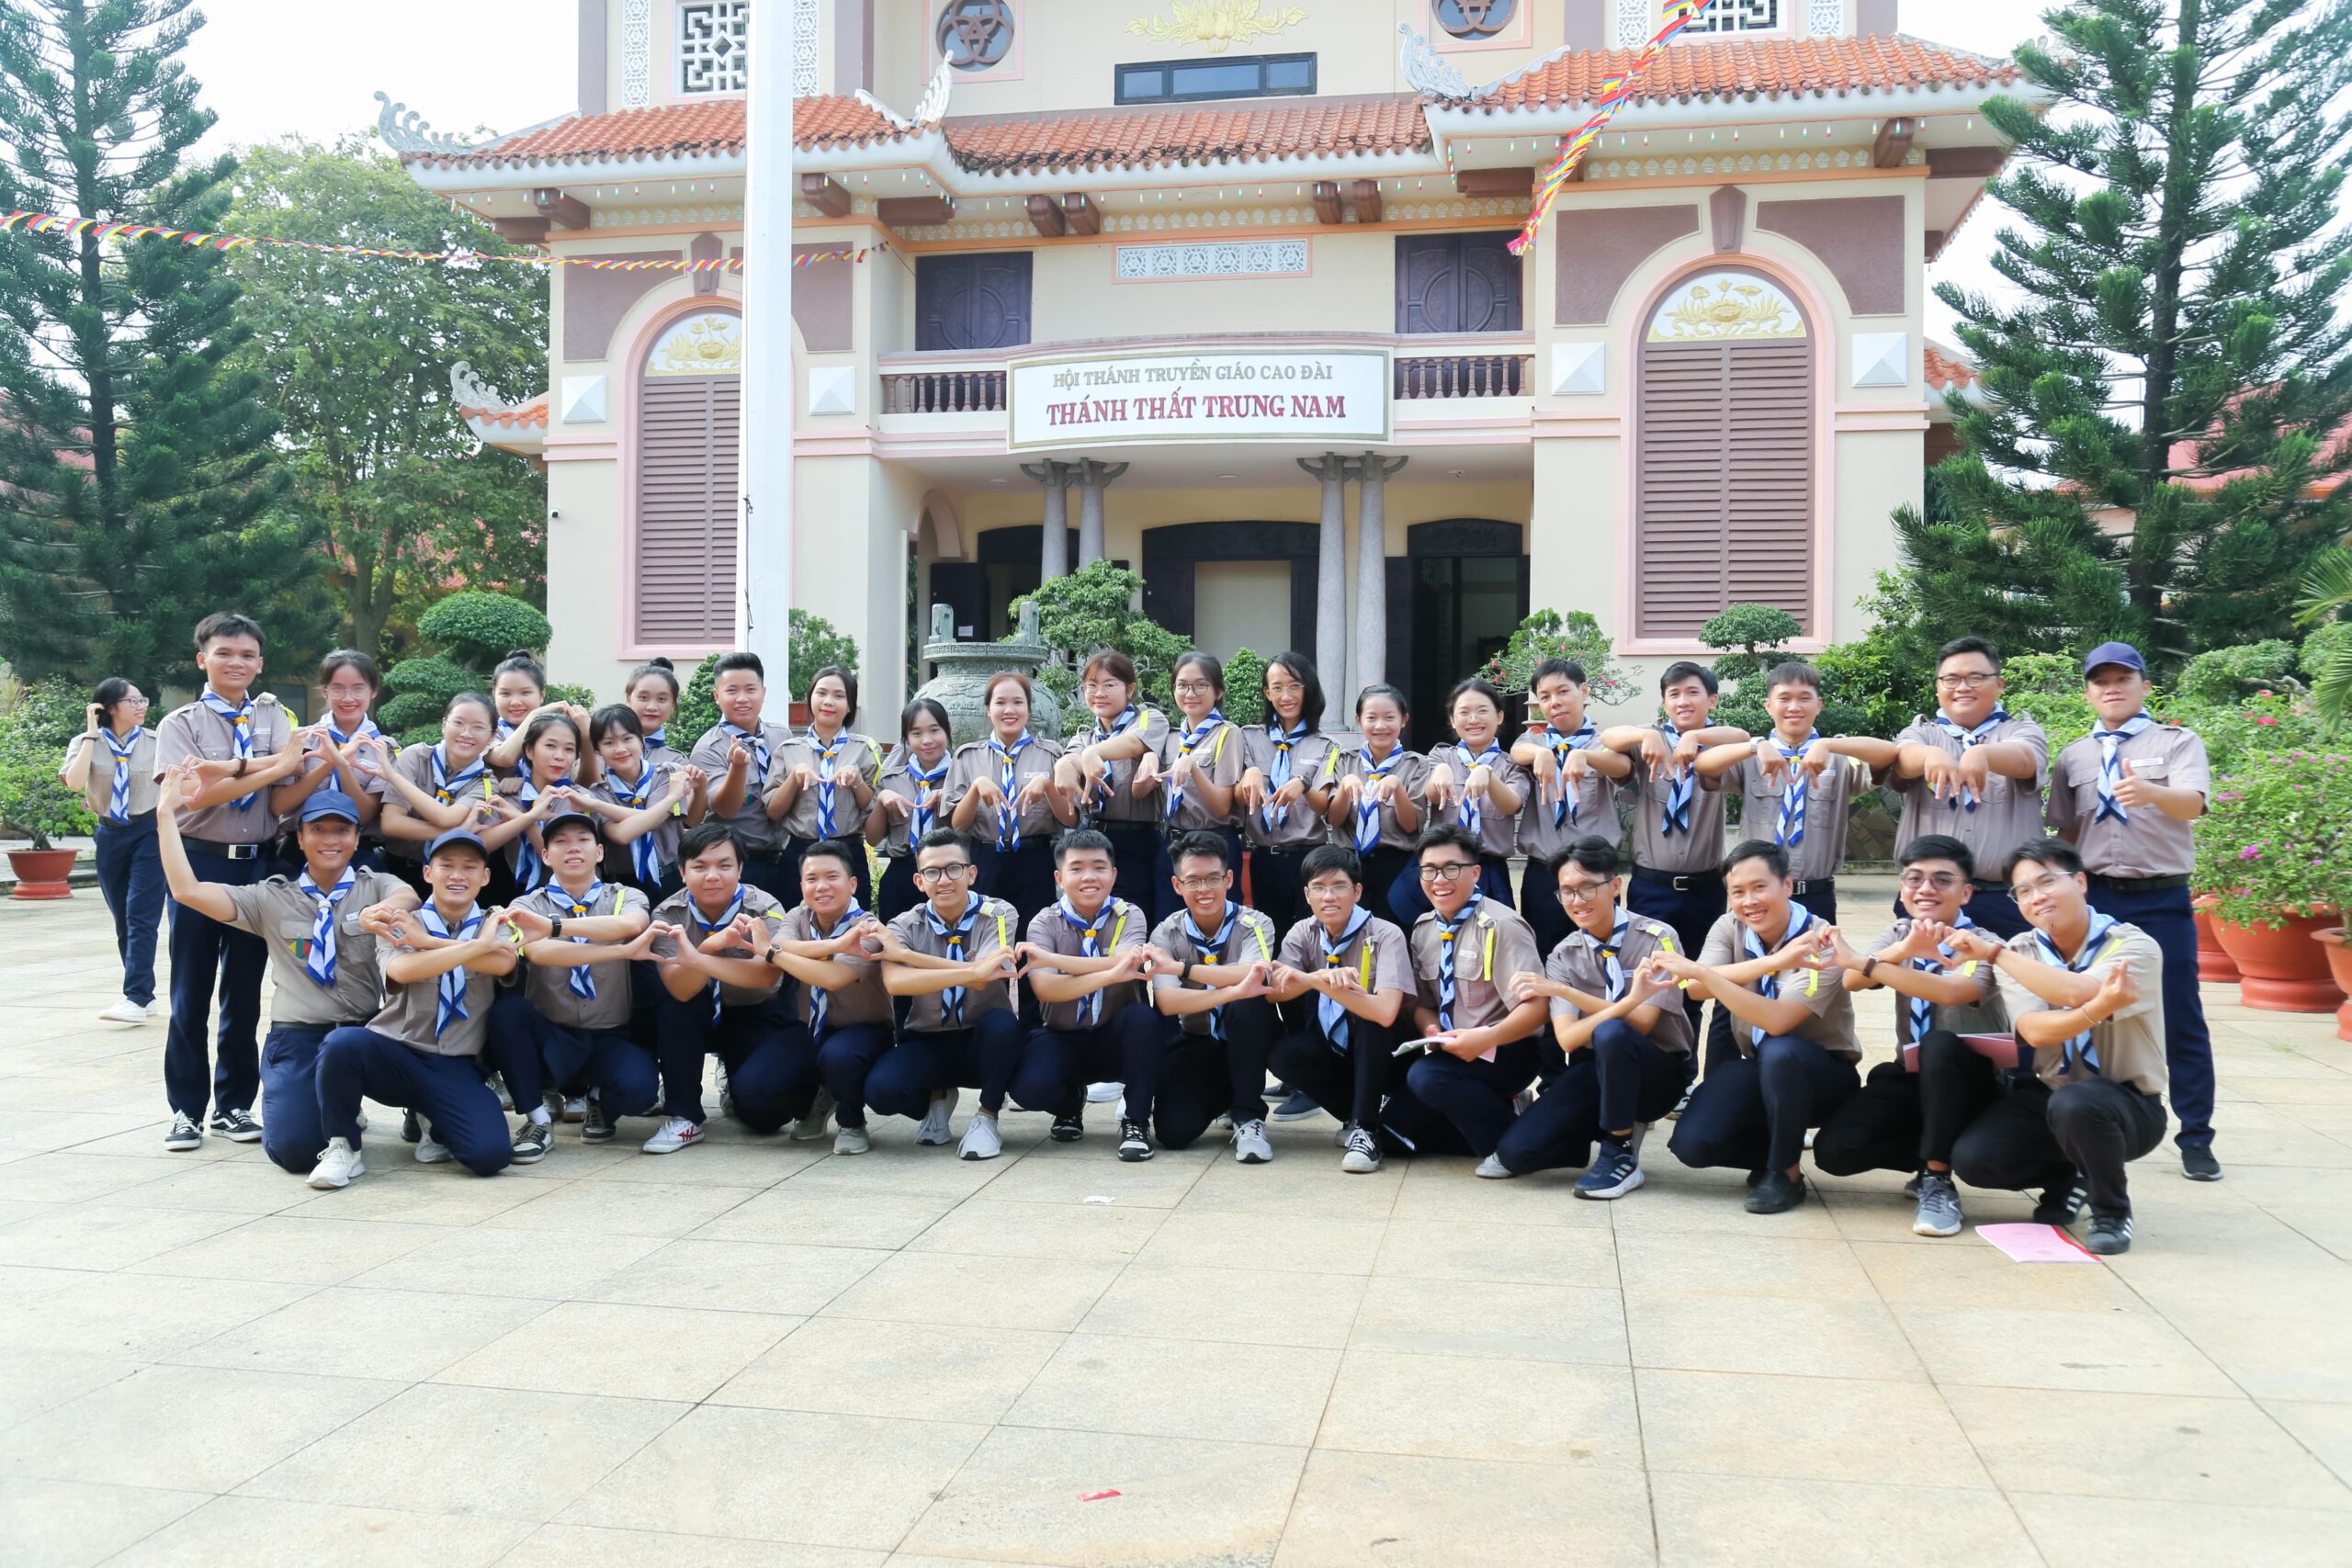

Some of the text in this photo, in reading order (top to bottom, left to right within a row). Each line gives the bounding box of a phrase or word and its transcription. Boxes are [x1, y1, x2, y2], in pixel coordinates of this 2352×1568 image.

[1053, 358, 1332, 391] HỘI THÁNH TRUYỀN GIÁO CAO ĐÀI
[1046, 386, 1346, 426] THÁNH THẤT TRUNG NAM
